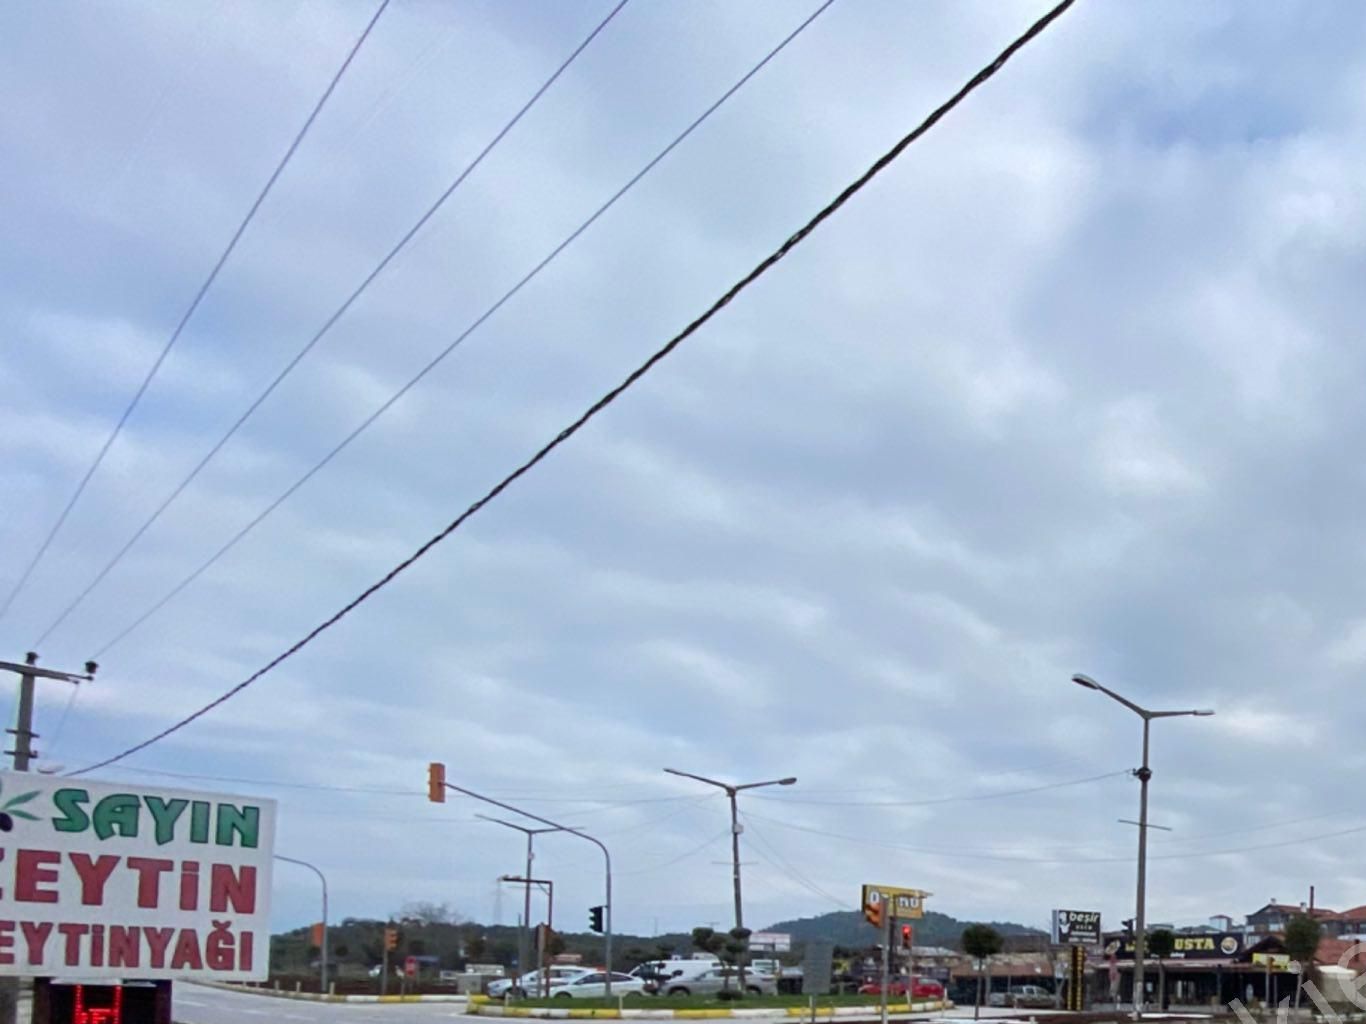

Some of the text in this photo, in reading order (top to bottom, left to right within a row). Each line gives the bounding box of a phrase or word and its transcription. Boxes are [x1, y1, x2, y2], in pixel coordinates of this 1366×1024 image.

[51, 787, 260, 849] SAYIN
[0, 847, 257, 915] EYTİN
[1174, 938, 1215, 950] USTA
